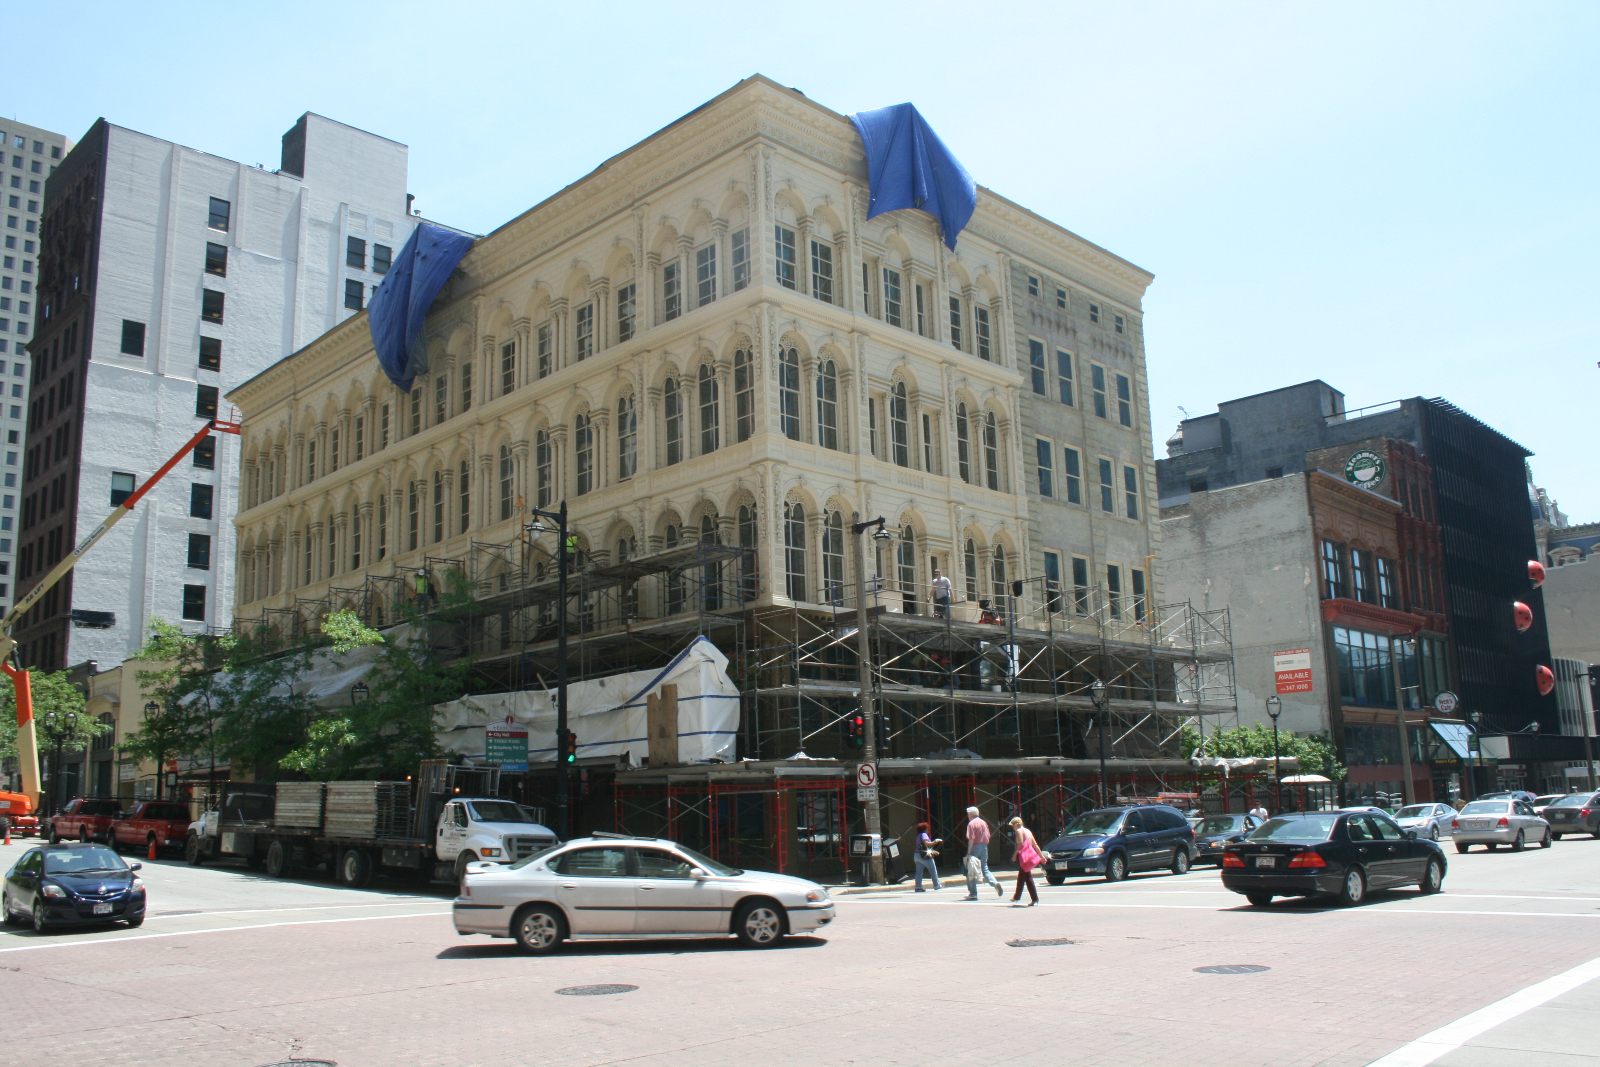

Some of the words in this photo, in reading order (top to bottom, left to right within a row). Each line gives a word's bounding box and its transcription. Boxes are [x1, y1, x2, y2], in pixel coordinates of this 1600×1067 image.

[1346, 452, 1381, 471] Steamers
[79, 538, 91, 550] United
[91, 526, 104, 539] Rentals
[34, 583, 45, 595] LIFT
[1278, 672, 1308, 680] AVAILABLE
